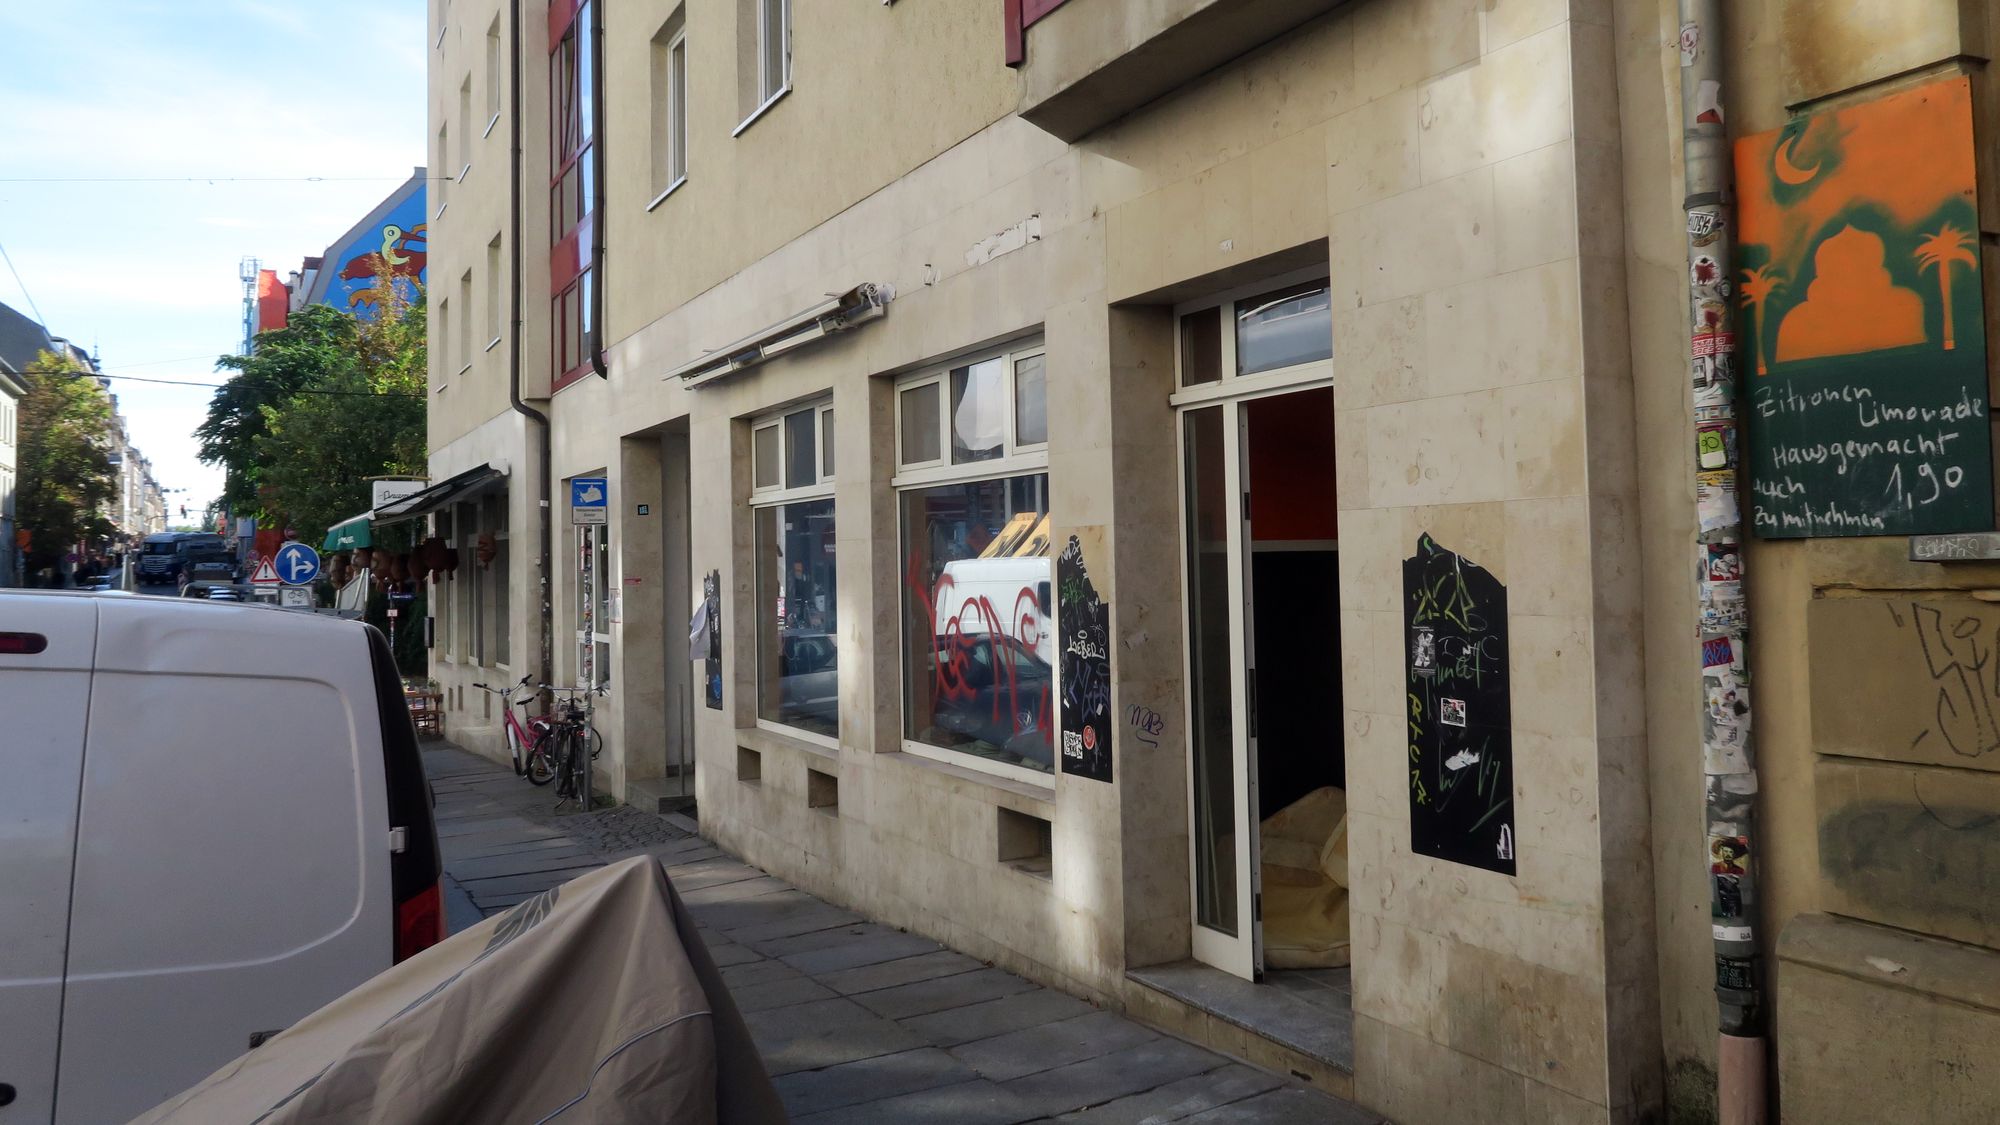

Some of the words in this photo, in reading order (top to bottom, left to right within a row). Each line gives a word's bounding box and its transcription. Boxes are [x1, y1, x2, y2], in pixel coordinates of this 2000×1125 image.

[1755, 379, 1872, 418] Zitronen
[1858, 385, 1984, 428] Limonade
[1772, 428, 1959, 475] Hausgemacht
[1884, 462, 1964, 510] 1,90
